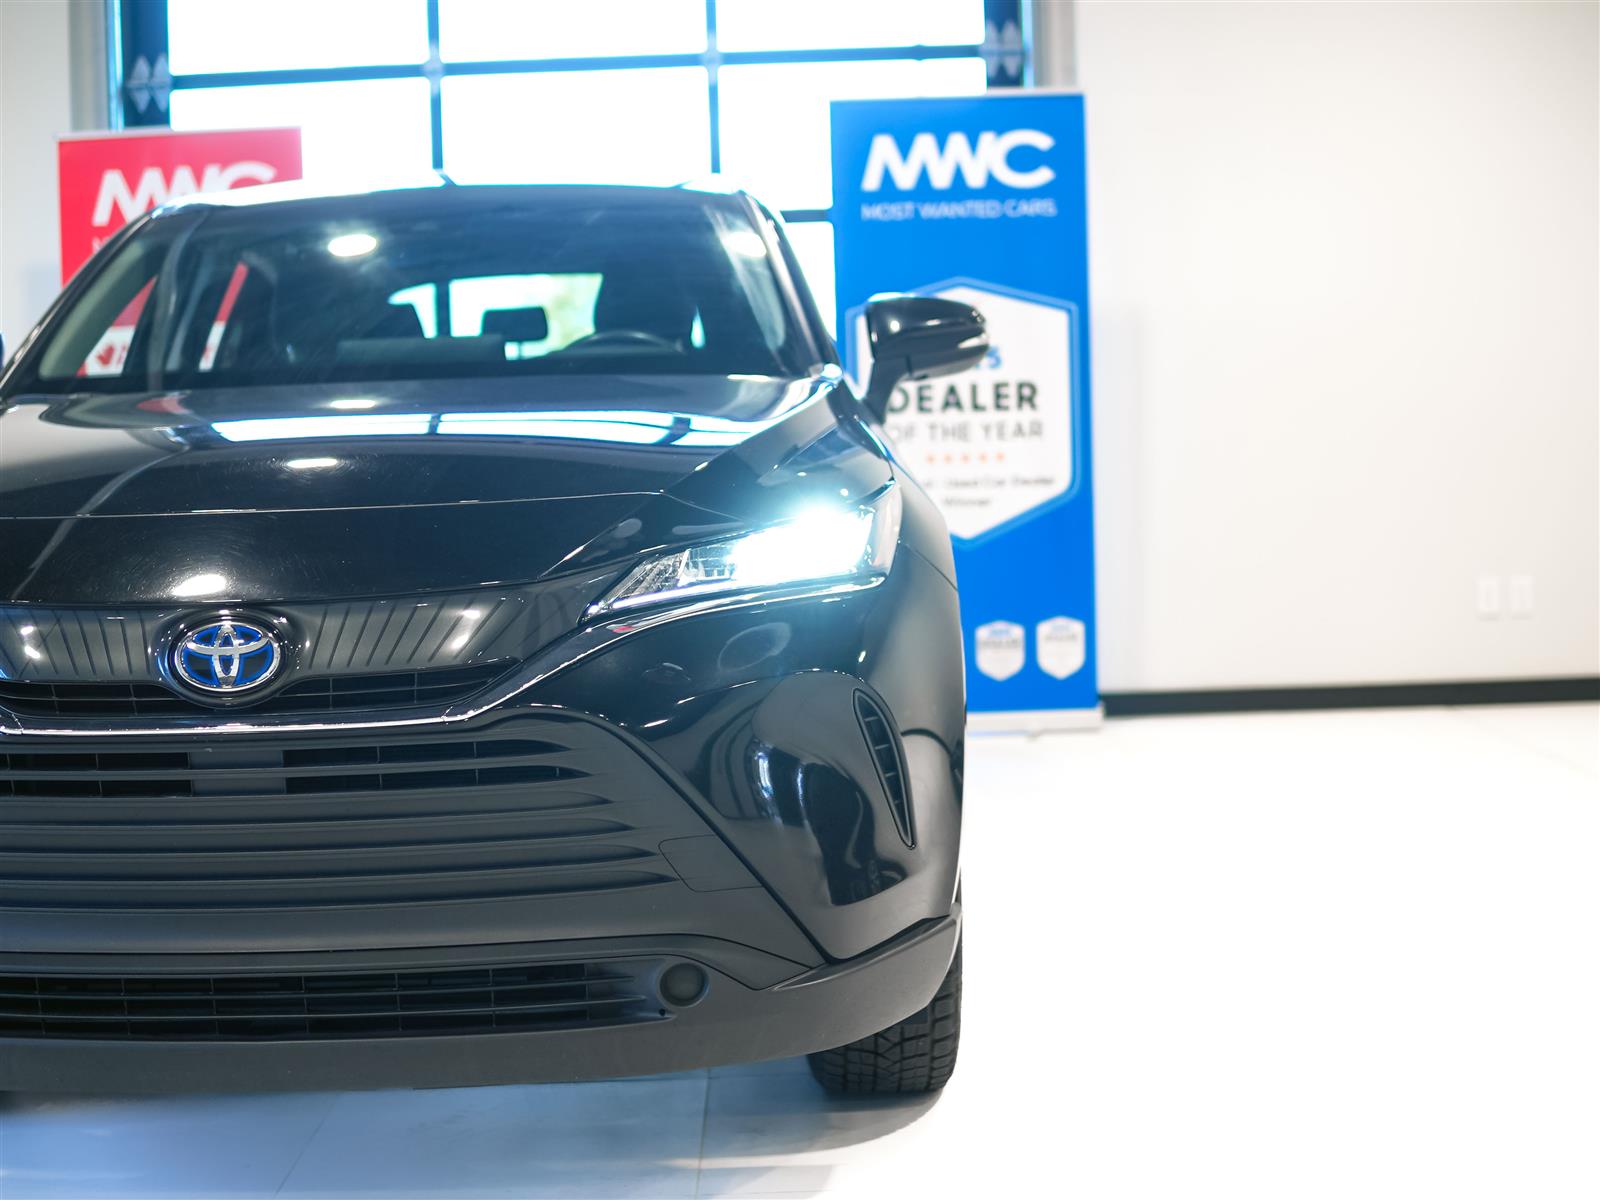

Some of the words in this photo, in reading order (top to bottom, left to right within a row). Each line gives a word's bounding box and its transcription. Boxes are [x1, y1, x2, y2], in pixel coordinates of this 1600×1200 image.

[861, 129, 1056, 191] MWC
[861, 201, 915, 221] MOST
[918, 199, 1000, 219] WANTED
[1004, 198, 1057, 217] CARS
[887, 381, 1038, 412] DEALER
[927, 421, 969, 441] THE
[981, 419, 1044, 440] YEAR
